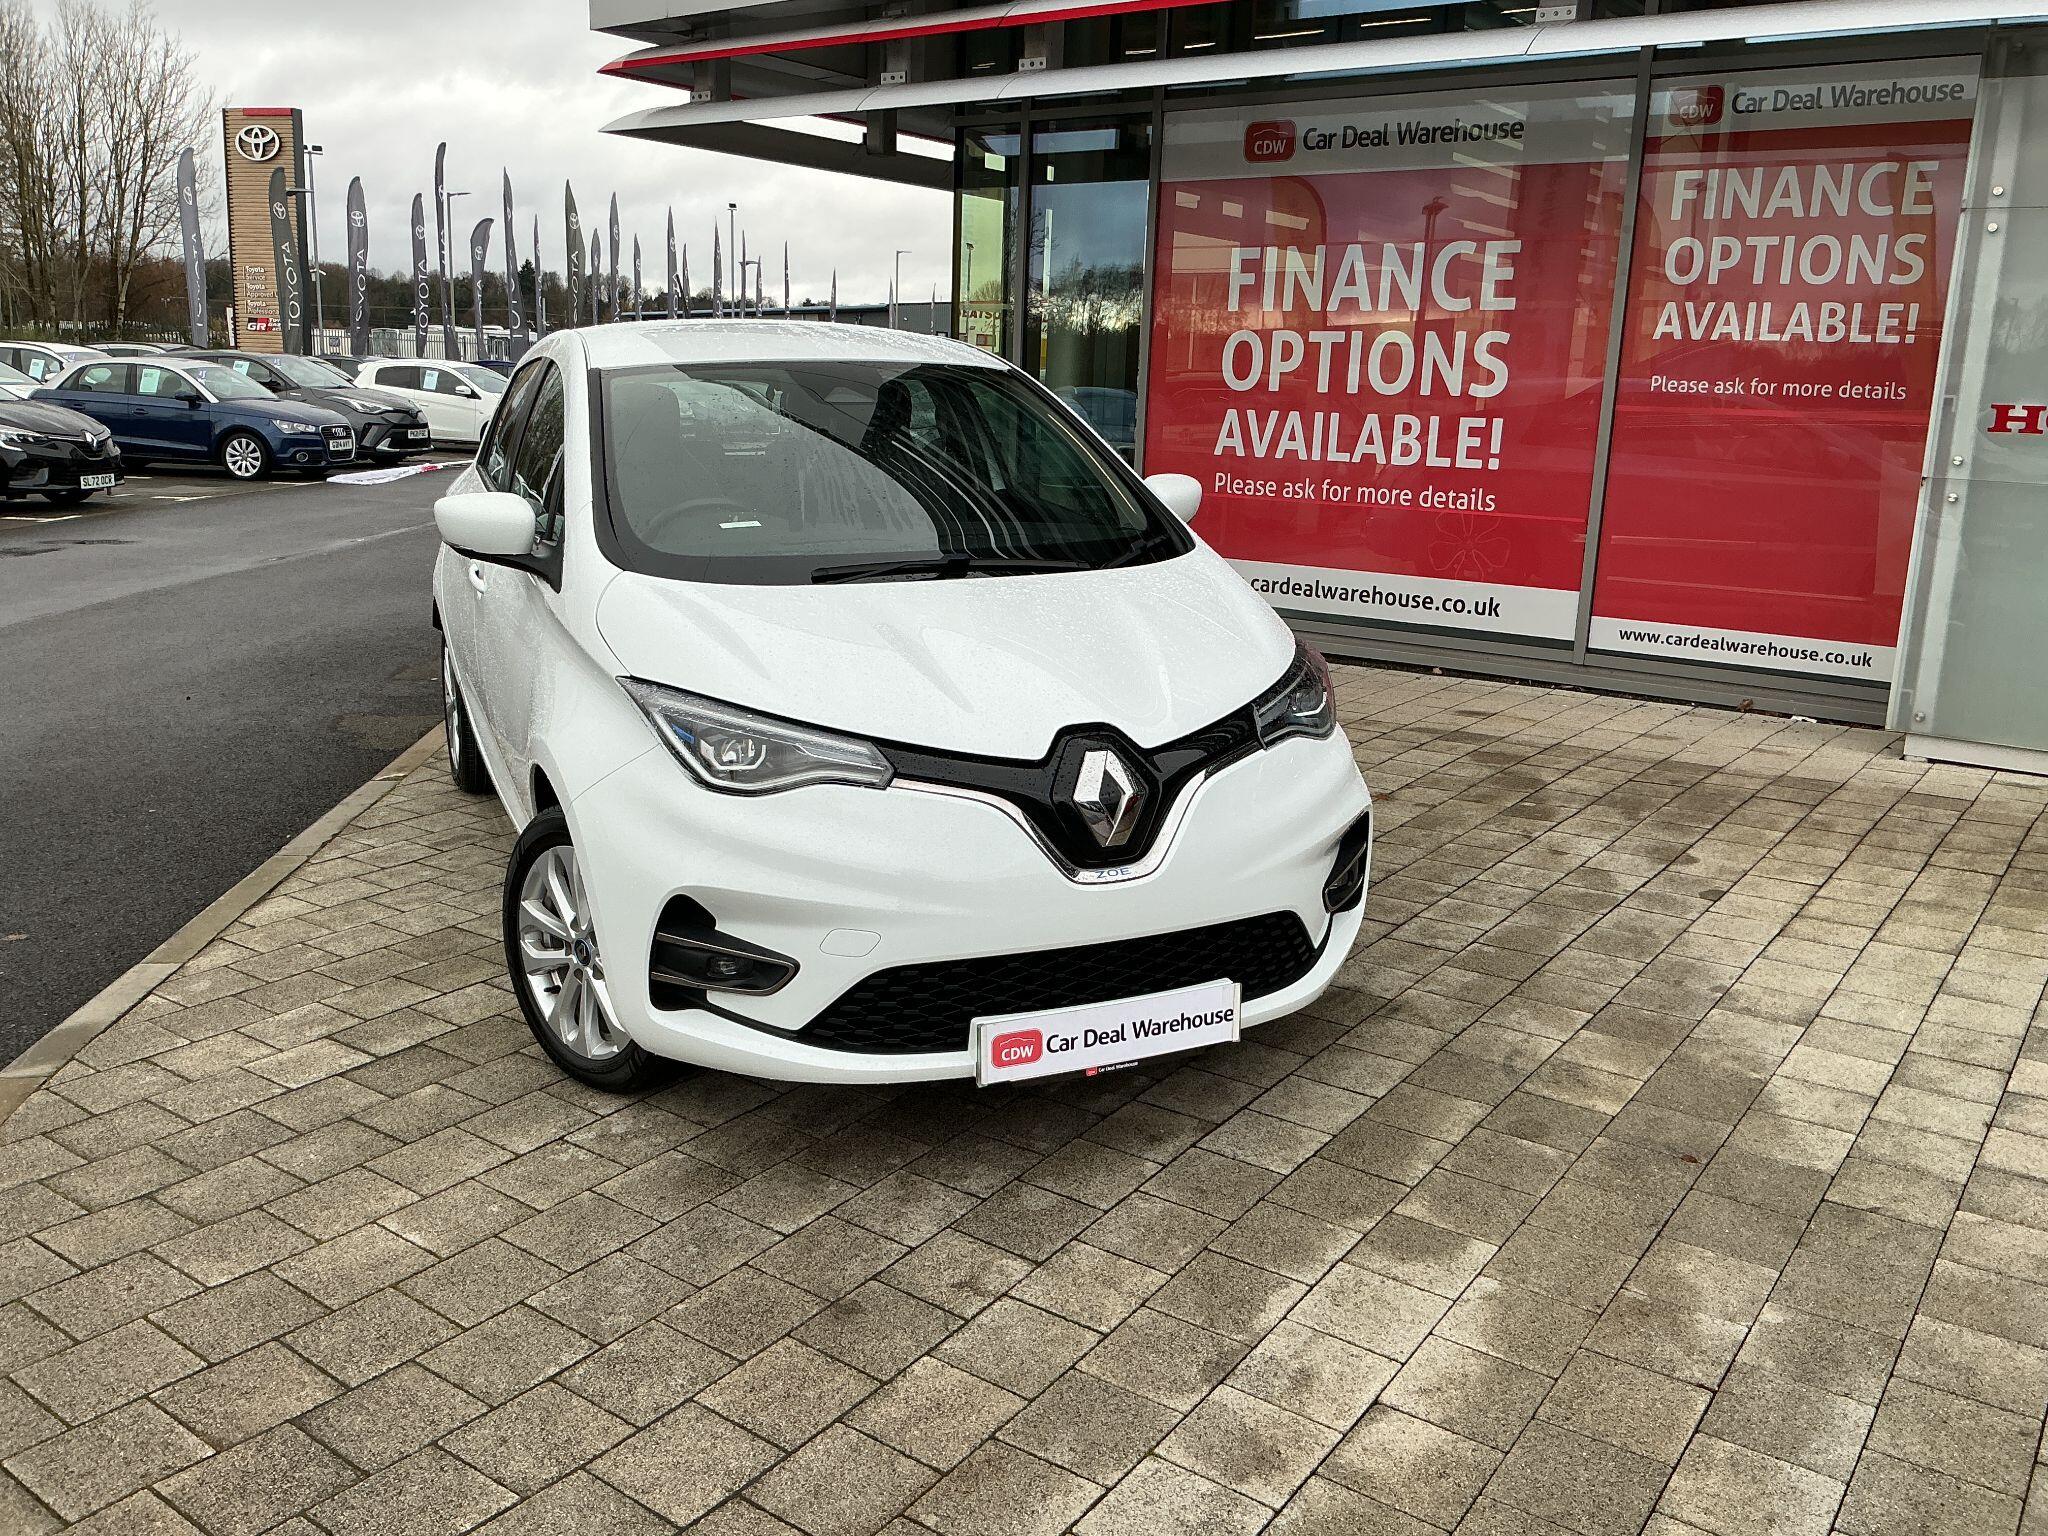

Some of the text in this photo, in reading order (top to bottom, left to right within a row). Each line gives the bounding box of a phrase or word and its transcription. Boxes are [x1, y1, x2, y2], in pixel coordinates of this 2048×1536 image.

[1680, 80, 1965, 120] CDW Car Deal Warehouse
[1253, 117, 1525, 156] CDW Car Deal Warehouse
[1670, 160, 1940, 222] FINANCE
[246, 265, 265, 274] Toyota
[1227, 239, 1523, 313] FINANCE
[1664, 232, 1928, 286] OPTIONS
[247, 283, 266, 291] Toyota
[248, 300, 267, 308] Toyota
[281, 242, 301, 331] TOYOTA
[247, 322, 267, 331] GR
[1652, 301, 1920, 344] AVAILABLE!
[1221, 329, 1510, 399] OPTIONS
[1650, 375, 1907, 402] Please ask for more details
[1987, 404, 2048, 434] H
[1213, 408, 1504, 471] AVAILABLE!
[83, 476, 99, 487] SL72
[1215, 472, 1496, 512] Please ask for more details
[1250, 576, 1501, 618] cardealwarehouse.co.uk
[1619, 628, 1873, 668] www.cardealwarehouse.co.uk
[1094, 867, 1131, 879] ZOE
[1001, 1006, 1234, 1062] CDW Car Deal Warehouse
